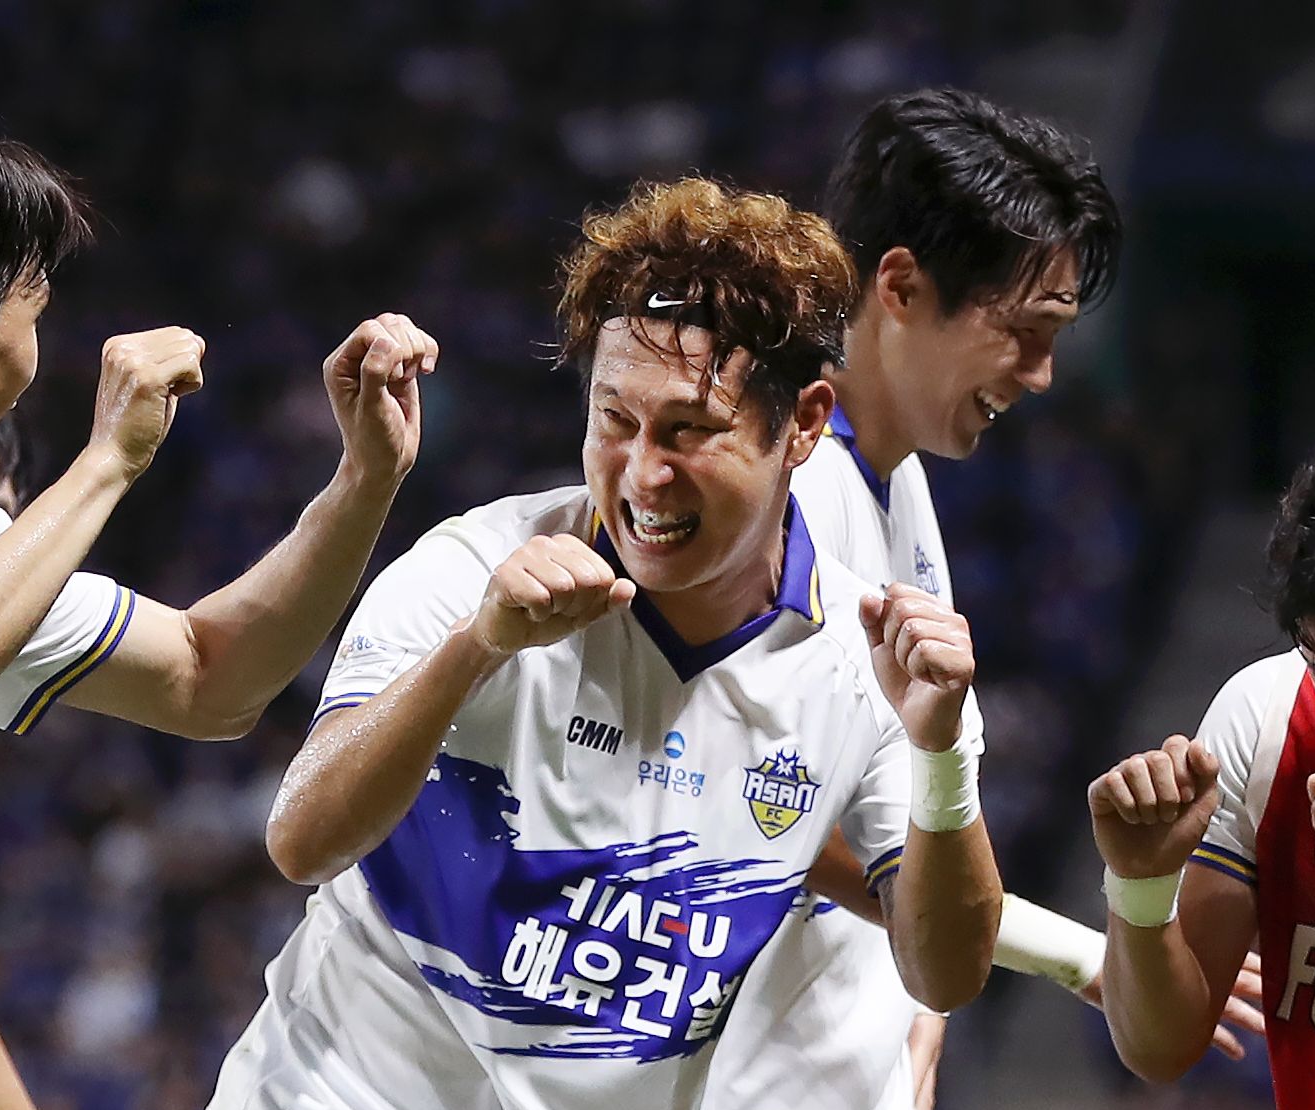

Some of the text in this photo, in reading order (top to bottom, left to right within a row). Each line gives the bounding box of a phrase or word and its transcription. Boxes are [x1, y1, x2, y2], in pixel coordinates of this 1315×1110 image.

[638, 760, 705, 797] 우리은행
[743, 770, 816, 812] ASAN
[766, 808, 783, 821] FC
